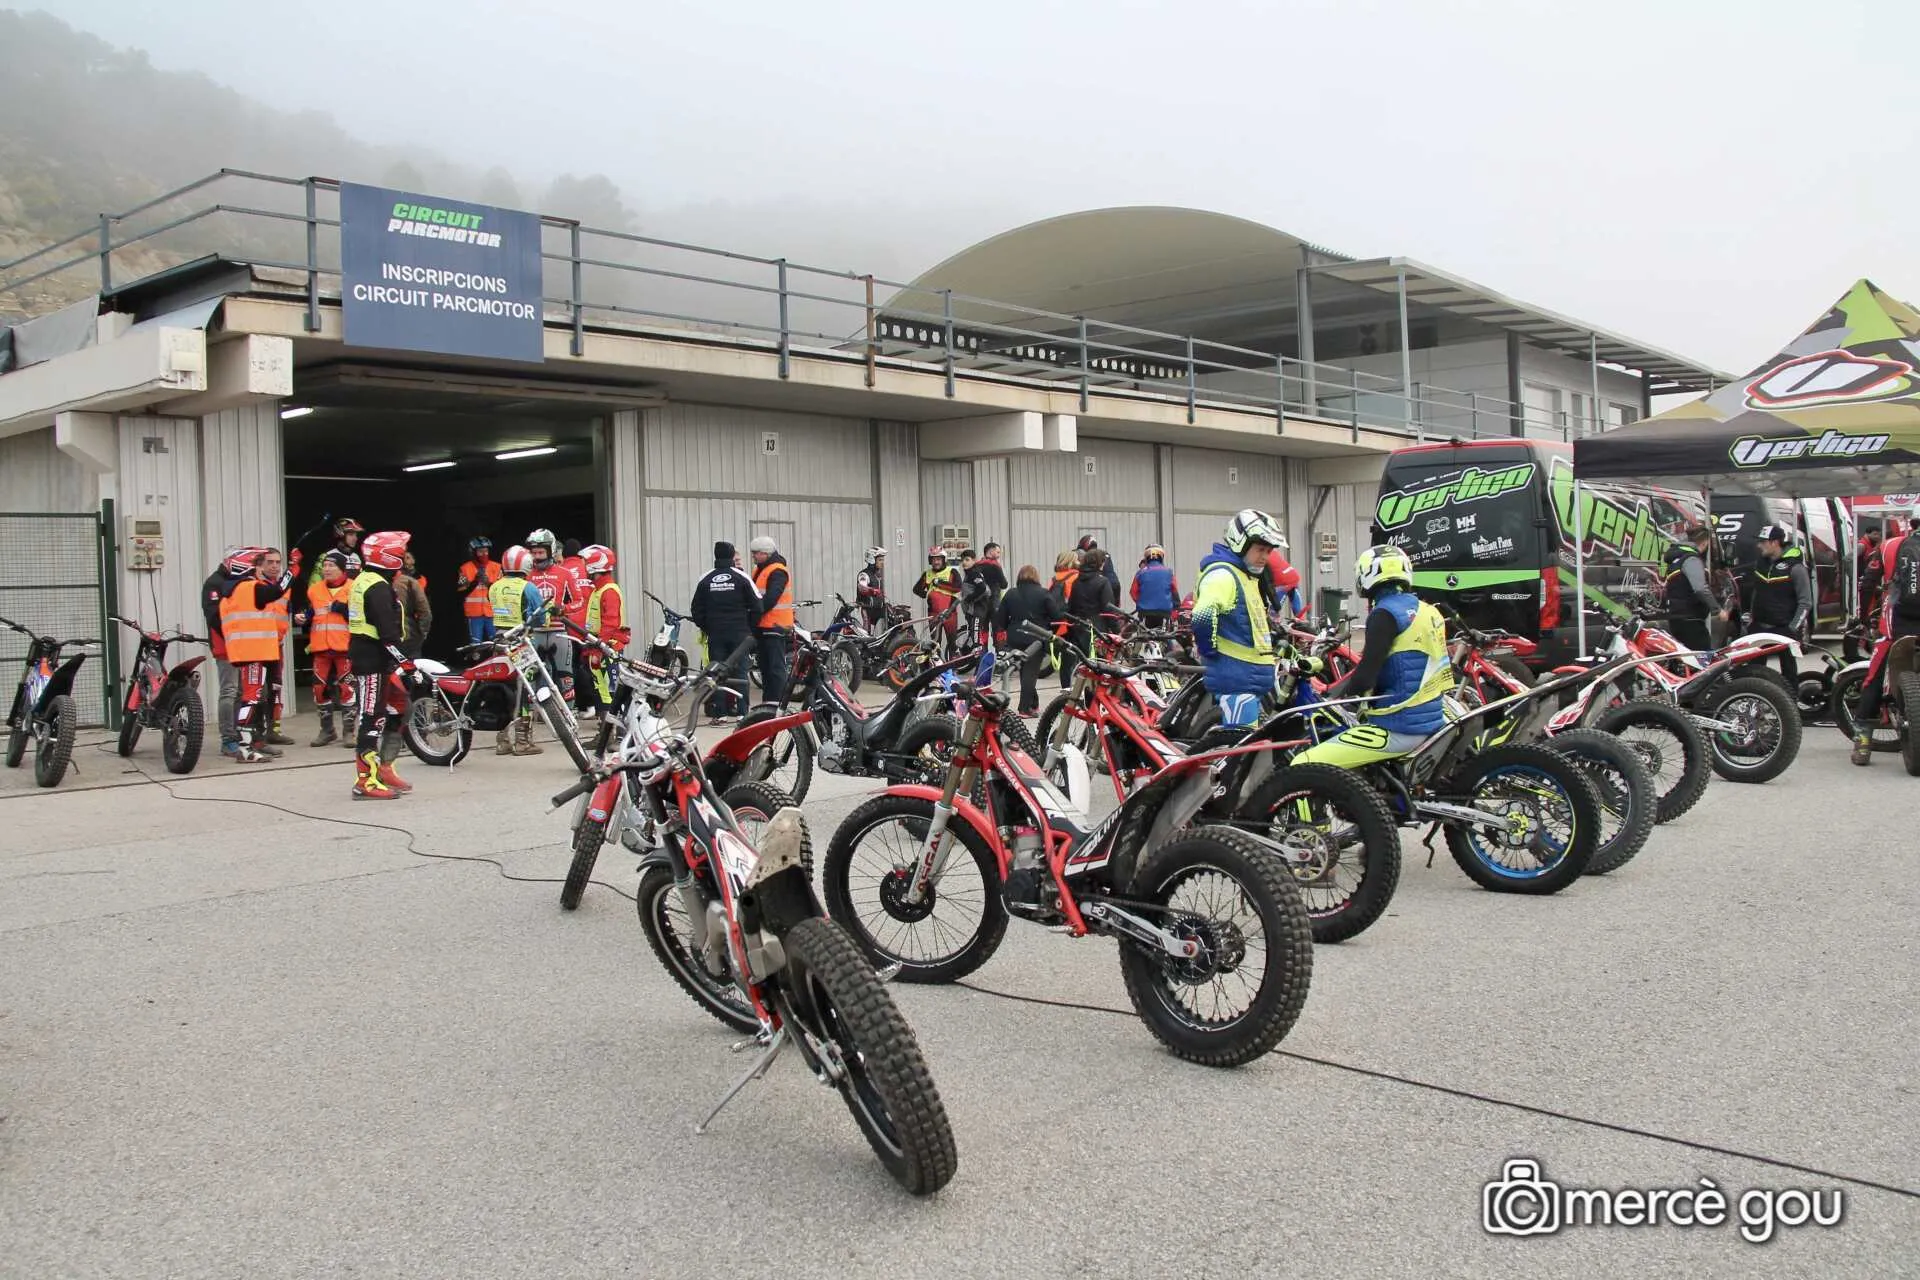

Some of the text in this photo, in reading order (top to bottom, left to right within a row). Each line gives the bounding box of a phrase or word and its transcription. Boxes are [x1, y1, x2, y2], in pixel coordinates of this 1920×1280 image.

[392, 203, 483, 229] CIRCUIT
[388, 219, 502, 248] PARCMOTOR
[382, 263, 507, 293] INSCRIPCIONS
[353, 284, 535, 320] CIRCUIT PARCMOTOR
[766, 439, 775, 451] 13
[1087, 462, 1094, 473] 12
[1456, 513, 1477, 529] HH
